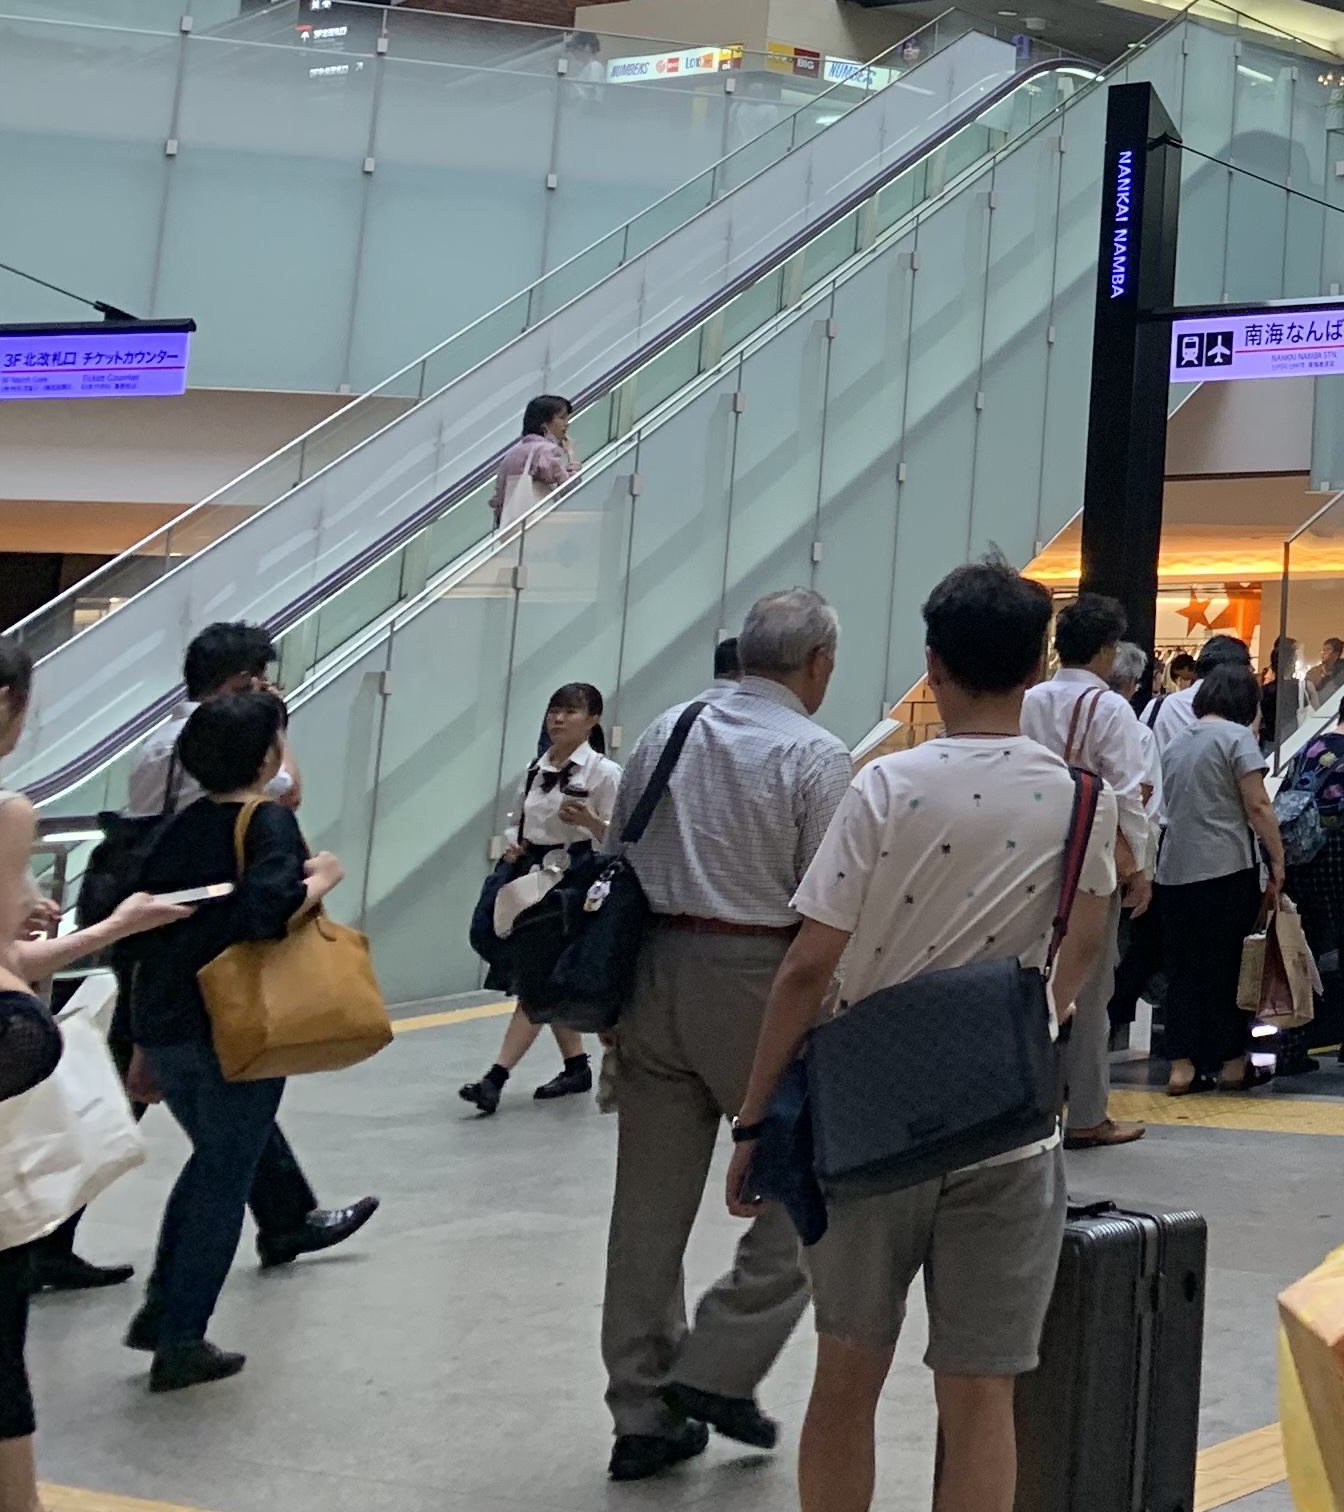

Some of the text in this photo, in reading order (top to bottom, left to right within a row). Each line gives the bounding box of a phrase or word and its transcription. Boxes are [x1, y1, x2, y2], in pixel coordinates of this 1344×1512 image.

[796, 58, 815, 71] BIG
[1110, 150, 1132, 299] NANKAI NAMBA
[3, 349, 179, 368] 3F北改札口 チケットカウンター
